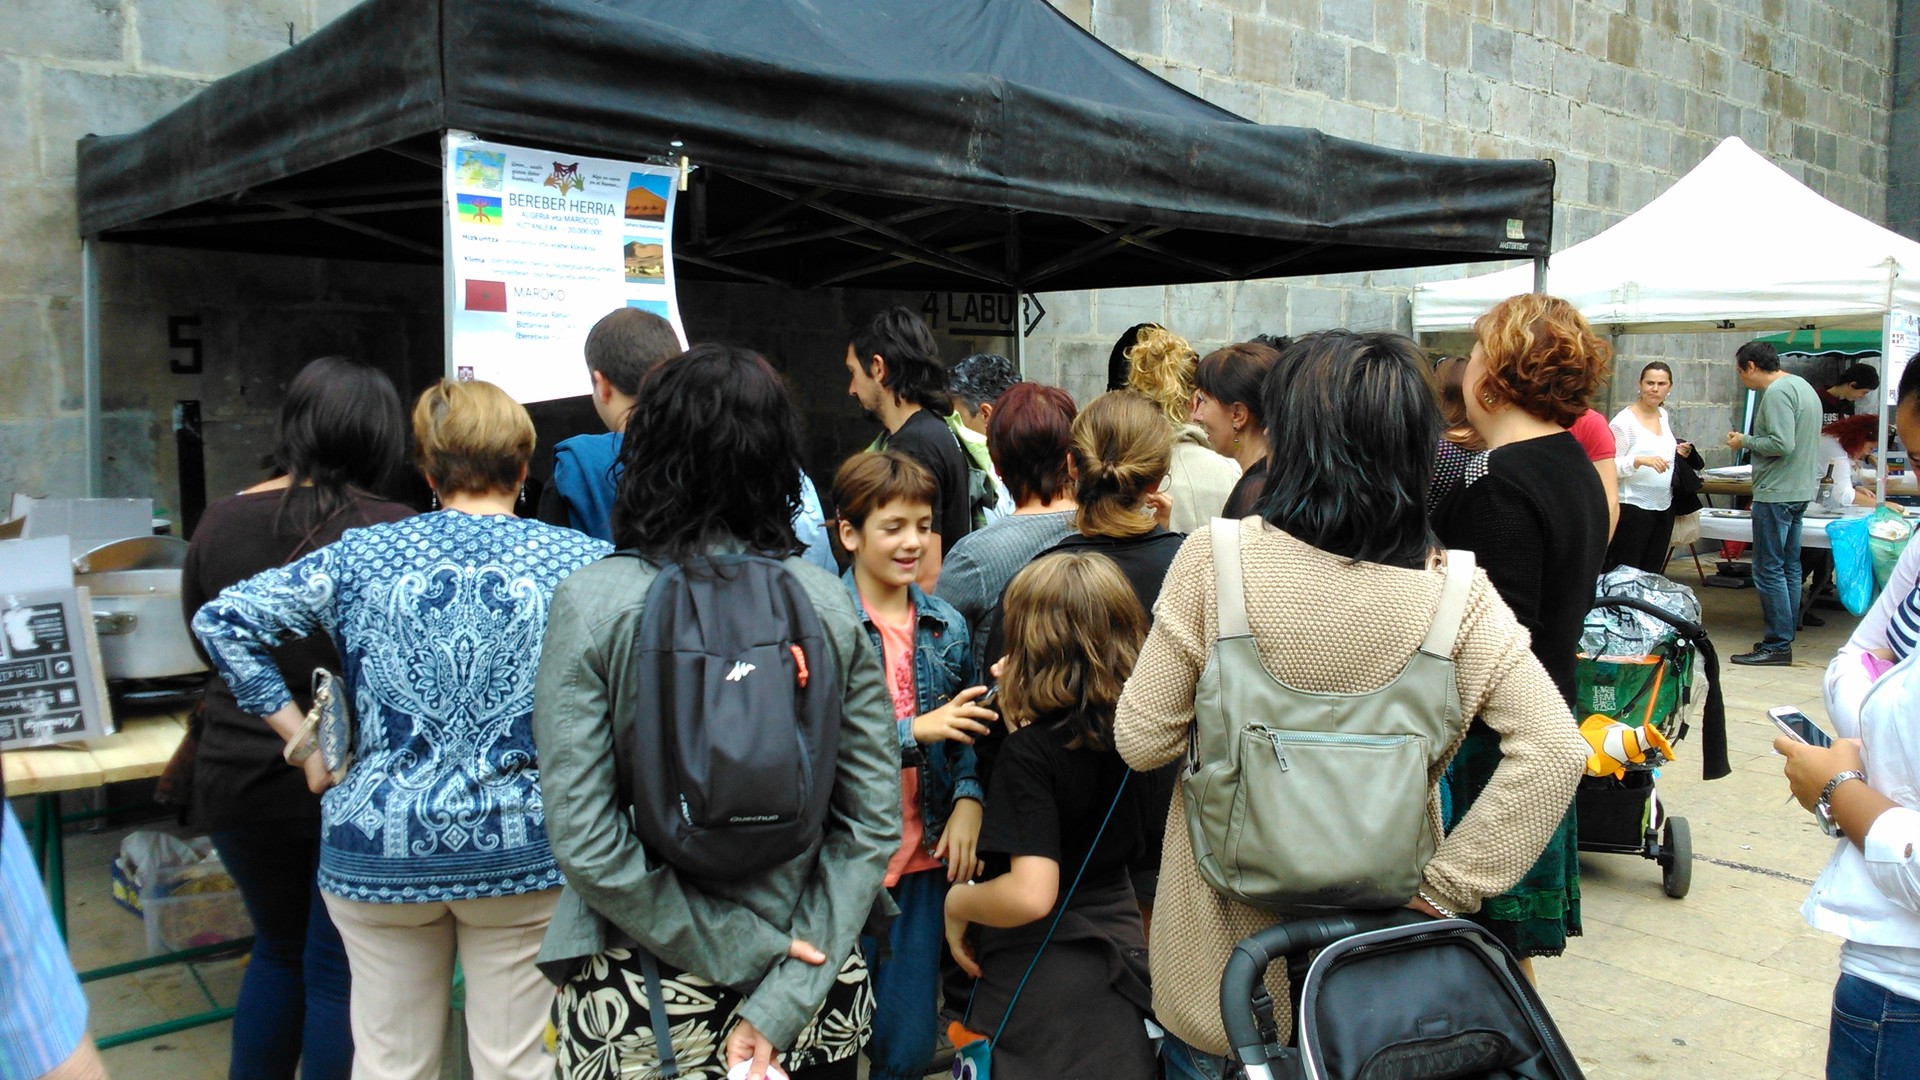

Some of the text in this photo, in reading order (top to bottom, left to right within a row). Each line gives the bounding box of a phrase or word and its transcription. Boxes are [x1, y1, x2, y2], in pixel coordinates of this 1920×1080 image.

[509, 193, 616, 216] BEREBER HERRIA
[521, 211, 550, 220] ALGERIA
[564, 215, 600, 226] MAROCCO
[462, 233, 499, 243] Hizkuntza
[463, 255, 485, 264] Klima
[514, 286, 566, 301] MAROKO
[922, 292, 939, 329] 4
[168, 316, 202, 373] 5
[730, 814, 779, 823] Quechua
